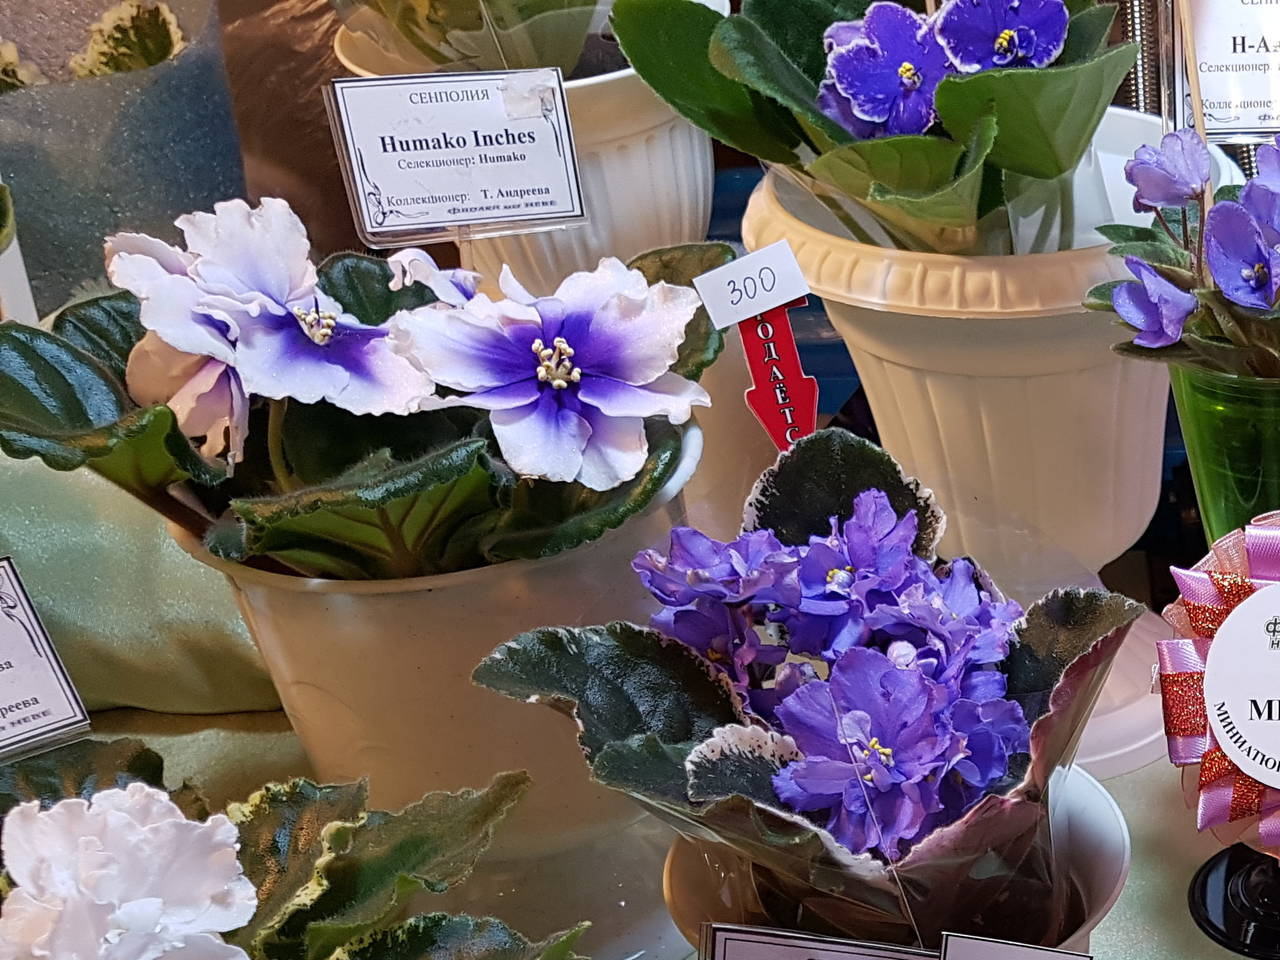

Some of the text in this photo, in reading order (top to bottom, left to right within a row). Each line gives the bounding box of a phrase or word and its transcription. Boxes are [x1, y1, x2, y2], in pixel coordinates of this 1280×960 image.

[409, 89, 490, 104] СЕНПОЛИЯ
[379, 128, 536, 153] Humako Inches
[397, 152, 526, 170] Селекционер: Humako
[386, 186, 550, 207] Коллекционер: Т. Андреева
[727, 266, 776, 306] 300
